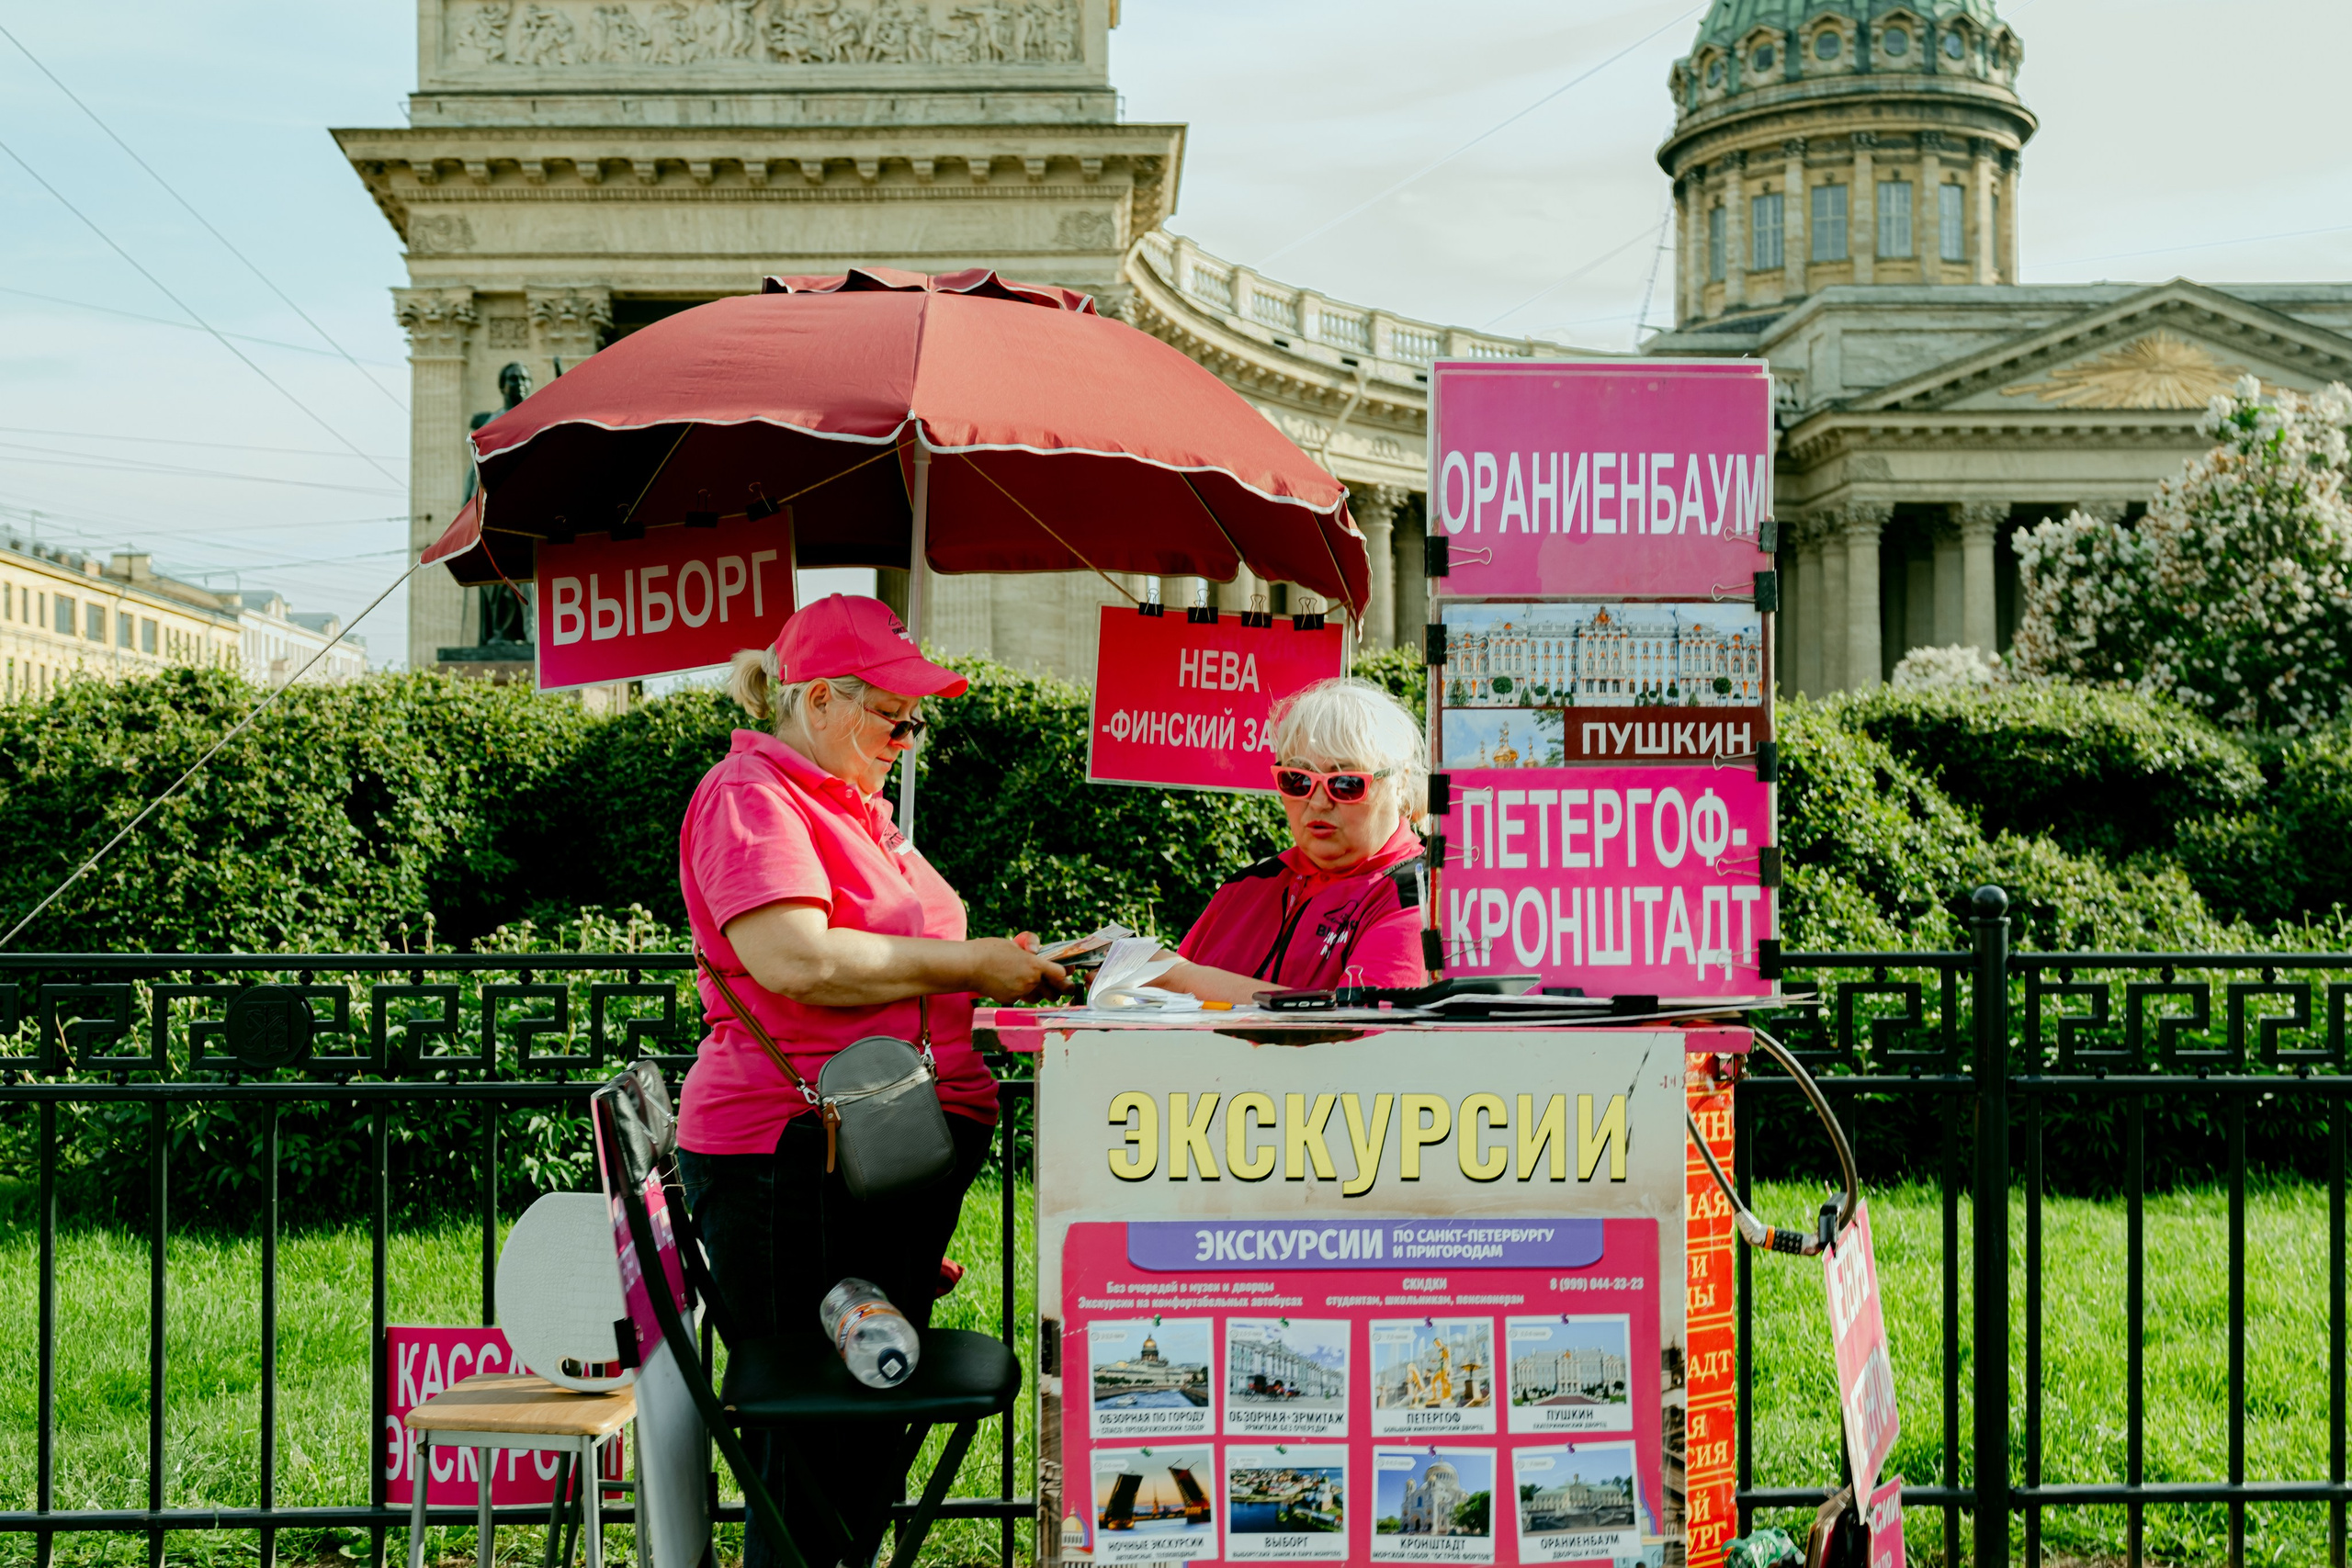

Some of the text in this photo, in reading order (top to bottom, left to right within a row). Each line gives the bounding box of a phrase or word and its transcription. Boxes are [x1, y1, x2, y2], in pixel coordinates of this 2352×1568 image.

[1441, 450, 1765, 536] ОРАНИЕНБАУМ
[552, 549, 777, 646] ВЫБОРГ
[1179, 648, 1260, 693] НЕВА
[1102, 707, 1277, 753] -ФИНСКИЙ ЗА
[1582, 722, 1750, 755] ПУШКИН
[1463, 787, 1747, 869] ПЕТЕРГОФ-
[1450, 886, 1760, 981] КРОНШТАДТ
[1107, 1091, 1628, 1198] ЭКСКУРСИИ
[1195, 1227, 1555, 1261] ЭКСКУРСИИ ПО САНКТ-ПЕТЕРБУРГУ
[1393, 1244, 1503, 1260] И ПРИГОРОДАМ
[1106, 1280, 1126, 1293] Без
[1127, 1280, 1178, 1296] очередей
[1189, 1282, 1220, 1295] музеи
[1232, 1281, 1275, 1294] дворцы
[1402, 1277, 1448, 1292] СКИДКИ
[1550, 1278, 1558, 1291] 8
[1078, 1293, 1304, 1311] Экскурсии на комфортабельных автобусах
[1455, 1293, 1525, 1307] пенсионерам
[1099, 1409, 1206, 1424] ОБЗОРНАЯ ПО ГОРОДУ
[1407, 1412, 1462, 1425] ПЕТЕРГОФ
[1546, 1408, 1594, 1420] ПУШКИН
[1108, 1537, 1205, 1552] НОЧНЫЕ ЭКСКУРСИИ
[1264, 1536, 1310, 1548] ВЫБОРГ
[1399, 1538, 1467, 1551] КРОНШТАДТ
[1540, 1534, 1621, 1551] ОРАНИЕНБАУМ
